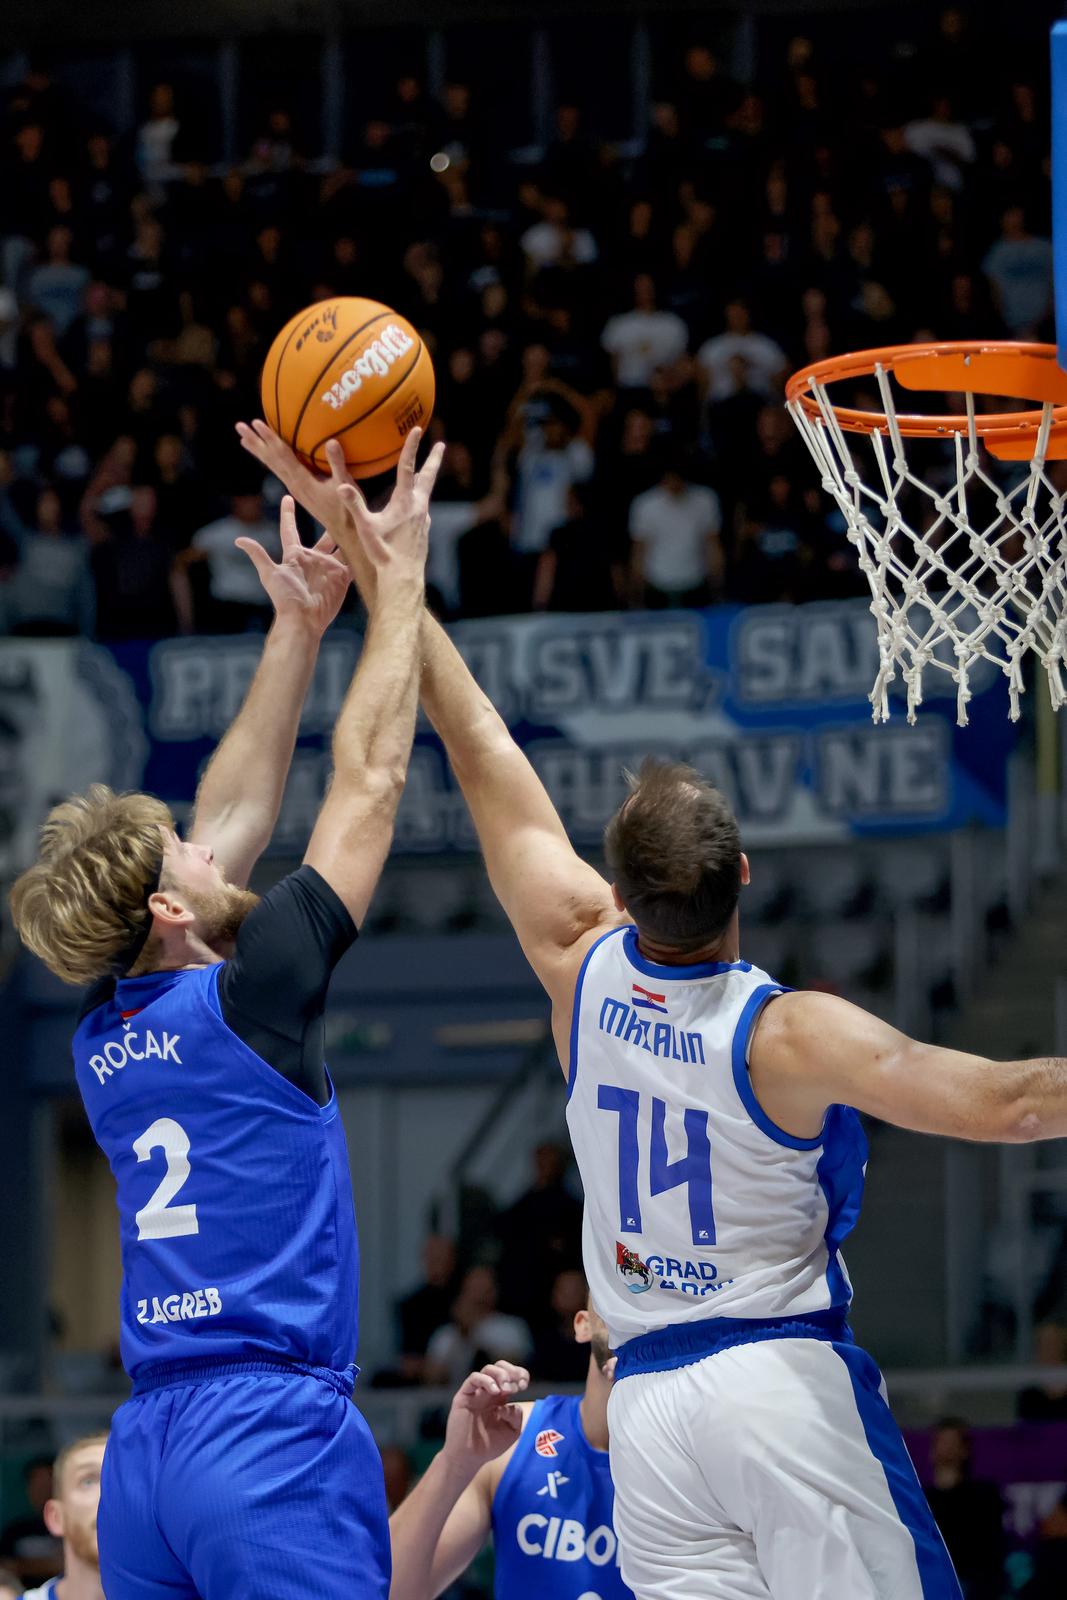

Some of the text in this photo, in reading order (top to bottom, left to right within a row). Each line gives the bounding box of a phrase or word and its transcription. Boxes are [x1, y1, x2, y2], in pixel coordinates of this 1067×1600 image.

[321, 323, 414, 409] Wilson
[823, 734, 935, 807] NE
[88, 1022, 183, 1086] ROČAK
[132, 1117, 199, 1241] 2
[645, 1255, 718, 1281] GRAD
[136, 1287, 223, 1325] ZAGREB
[516, 1513, 622, 1567] CIBO
